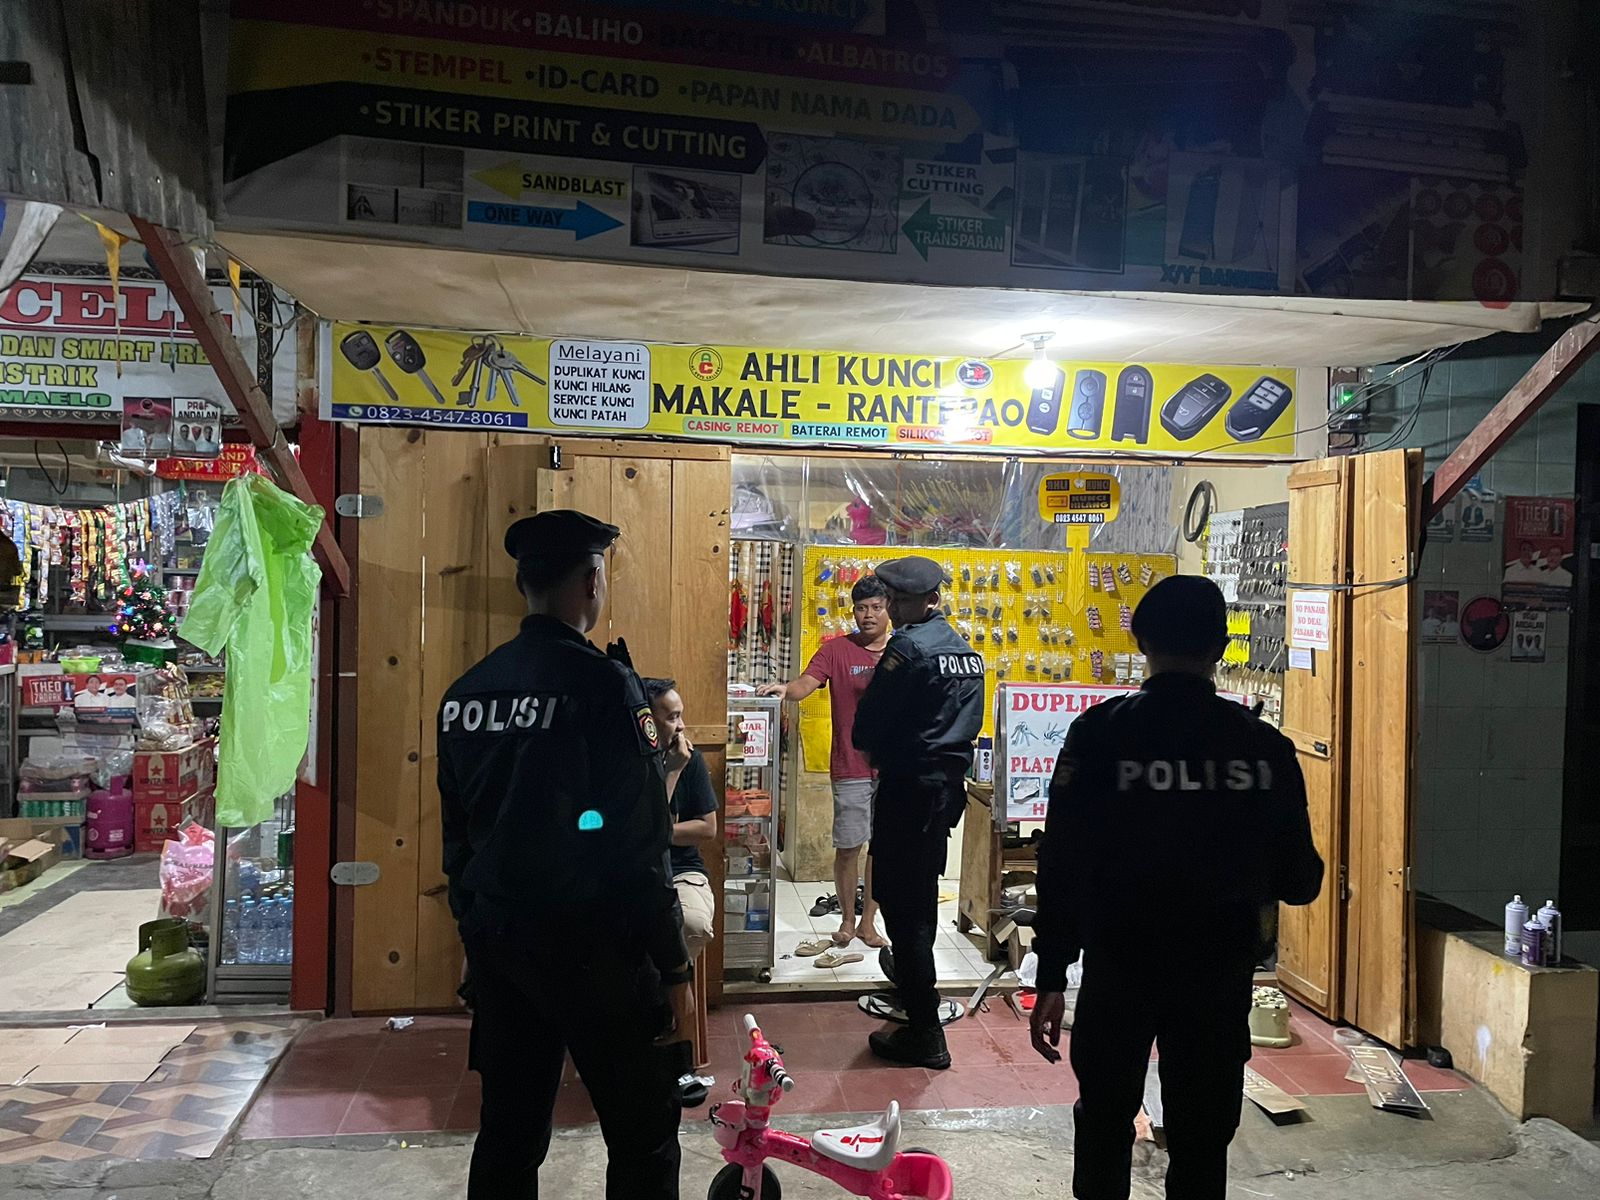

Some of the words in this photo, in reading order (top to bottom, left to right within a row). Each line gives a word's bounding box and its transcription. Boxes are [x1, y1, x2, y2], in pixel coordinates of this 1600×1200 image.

[535, 12, 644, 45] BALIHO
[807, 41, 949, 79] ALBATROS
[375, 47, 512, 85] STEMPEL
[538, 64, 659, 98] ID-CARD
[691, 79, 780, 112] PAPAN
[791, 90, 873, 120] NAMA
[881, 101, 957, 129] DADA
[375, 101, 481, 135] STIKER
[493, 112, 582, 143] PRINT
[591, 121, 610, 147] &
[622, 125, 747, 159] CUTTING
[915, 163, 977, 179] STIKER
[522, 173, 625, 196] SANDBLAST
[907, 178, 985, 196] CUTTING
[483, 205, 521, 223] ONE
[525, 208, 564, 226] WAY
[936, 216, 984, 233] STIKER
[0, 334, 55, 359] DAN
[62, 338, 154, 363] SMART
[559, 344, 641, 364] Melayani
[554, 365, 608, 380] DUPLIKAT
[613, 368, 645, 381] KUNCI
[740, 352, 820, 385] AHLI
[837, 355, 942, 389] KUNCI
[554, 380, 588, 393] KUNCI
[592, 381, 631, 394] HILANG
[553, 393, 598, 407] SERVICE
[601, 395, 635, 408] KUNCI
[652, 383, 802, 420] MAKALE
[367, 406, 513, 427] 0823-4547-8061
[553, 407, 588, 420] KUNCI
[592, 408, 627, 422] PATAH
[687, 420, 732, 433] CASING
[736, 423, 779, 435] REMOT
[791, 425, 841, 437] BATERAI
[846, 427, 888, 438] REMOT
[1071, 513, 1086, 523] 4547
[939, 655, 984, 676] POLISI
[32, 680, 62, 693] THEO
[442, 696, 557, 732] POLISI
[1011, 756, 1055, 773] PLAT
[1117, 759, 1272, 792] POLISI
